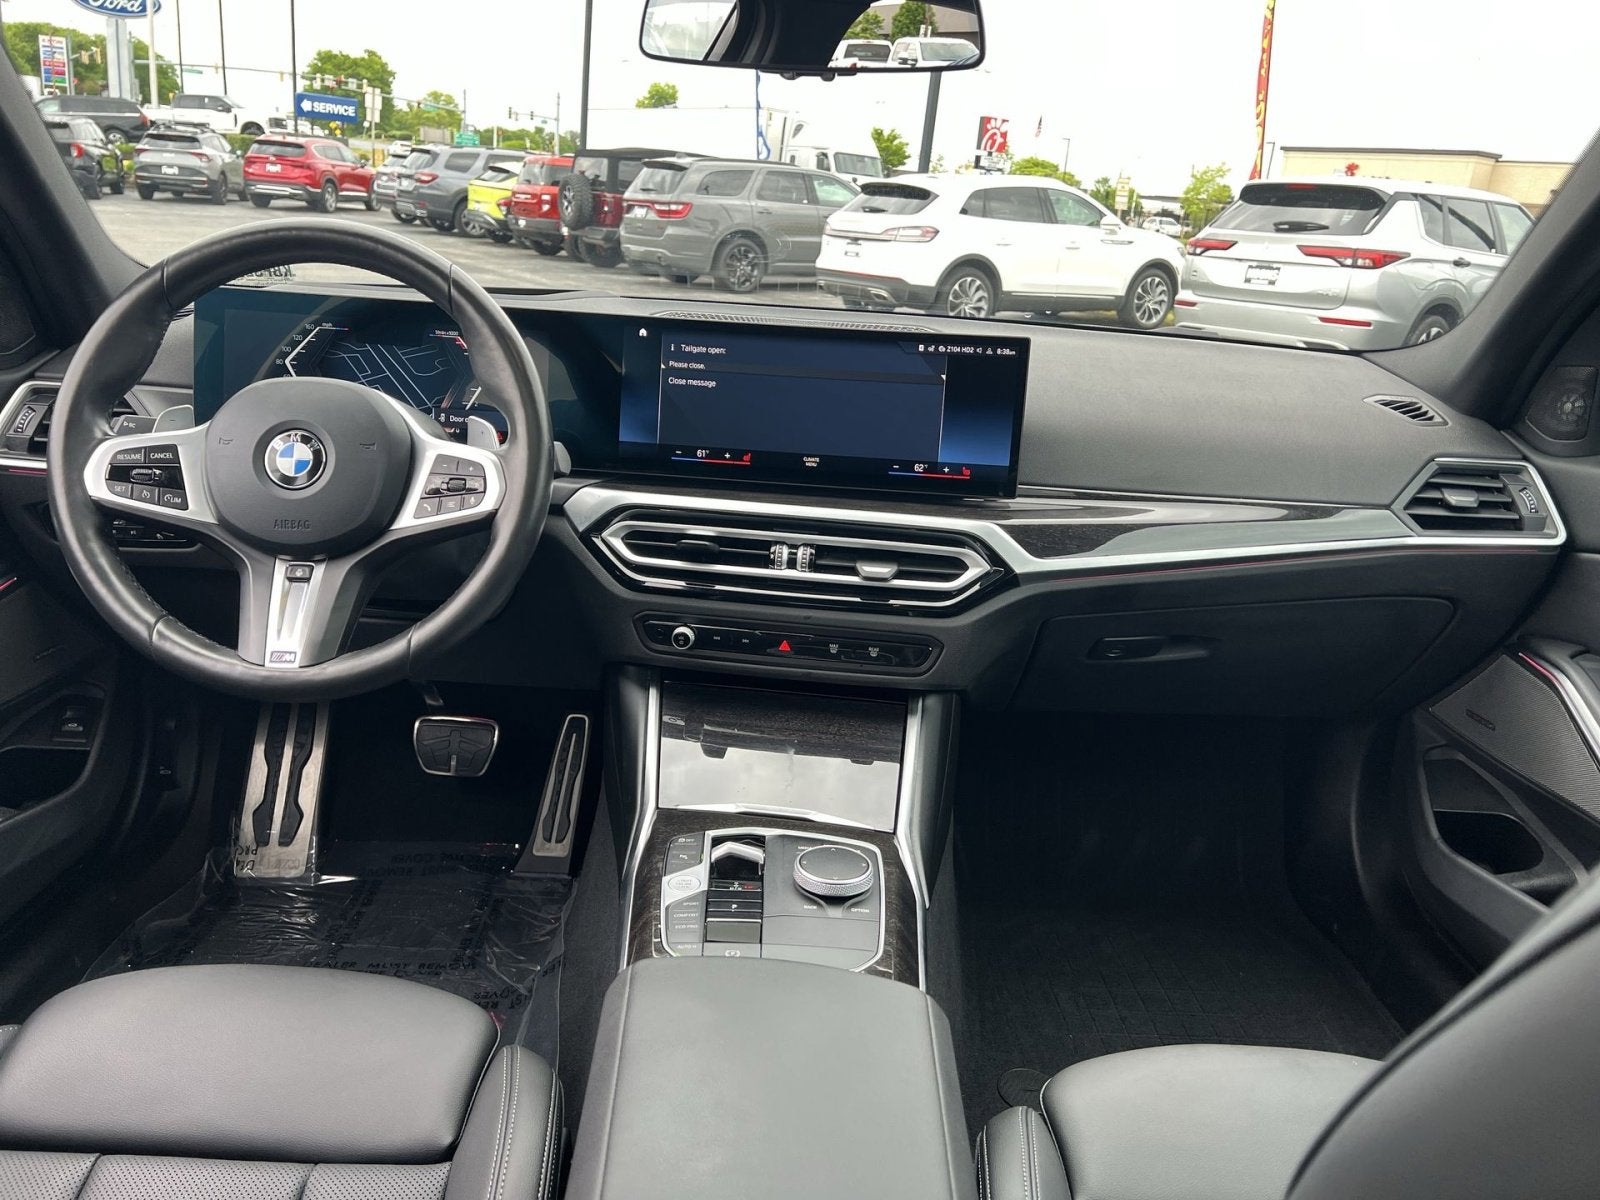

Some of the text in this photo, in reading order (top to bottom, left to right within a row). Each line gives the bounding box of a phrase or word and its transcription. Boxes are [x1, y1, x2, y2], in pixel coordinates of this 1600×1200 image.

[88, 0, 142, 12] ord
[312, 101, 356, 117] SERVICE
[680, 344, 707, 354] Tailgate
[961, 346, 975, 354] HD2
[669, 360, 688, 368] Please
[668, 376, 717, 389] Close message
[449, 415, 465, 423] Door
[271, 431, 321, 452] BMW
[116, 453, 142, 461] RESUME
[114, 485, 126, 493] SET
[272, 518, 312, 530] AIRBAG
